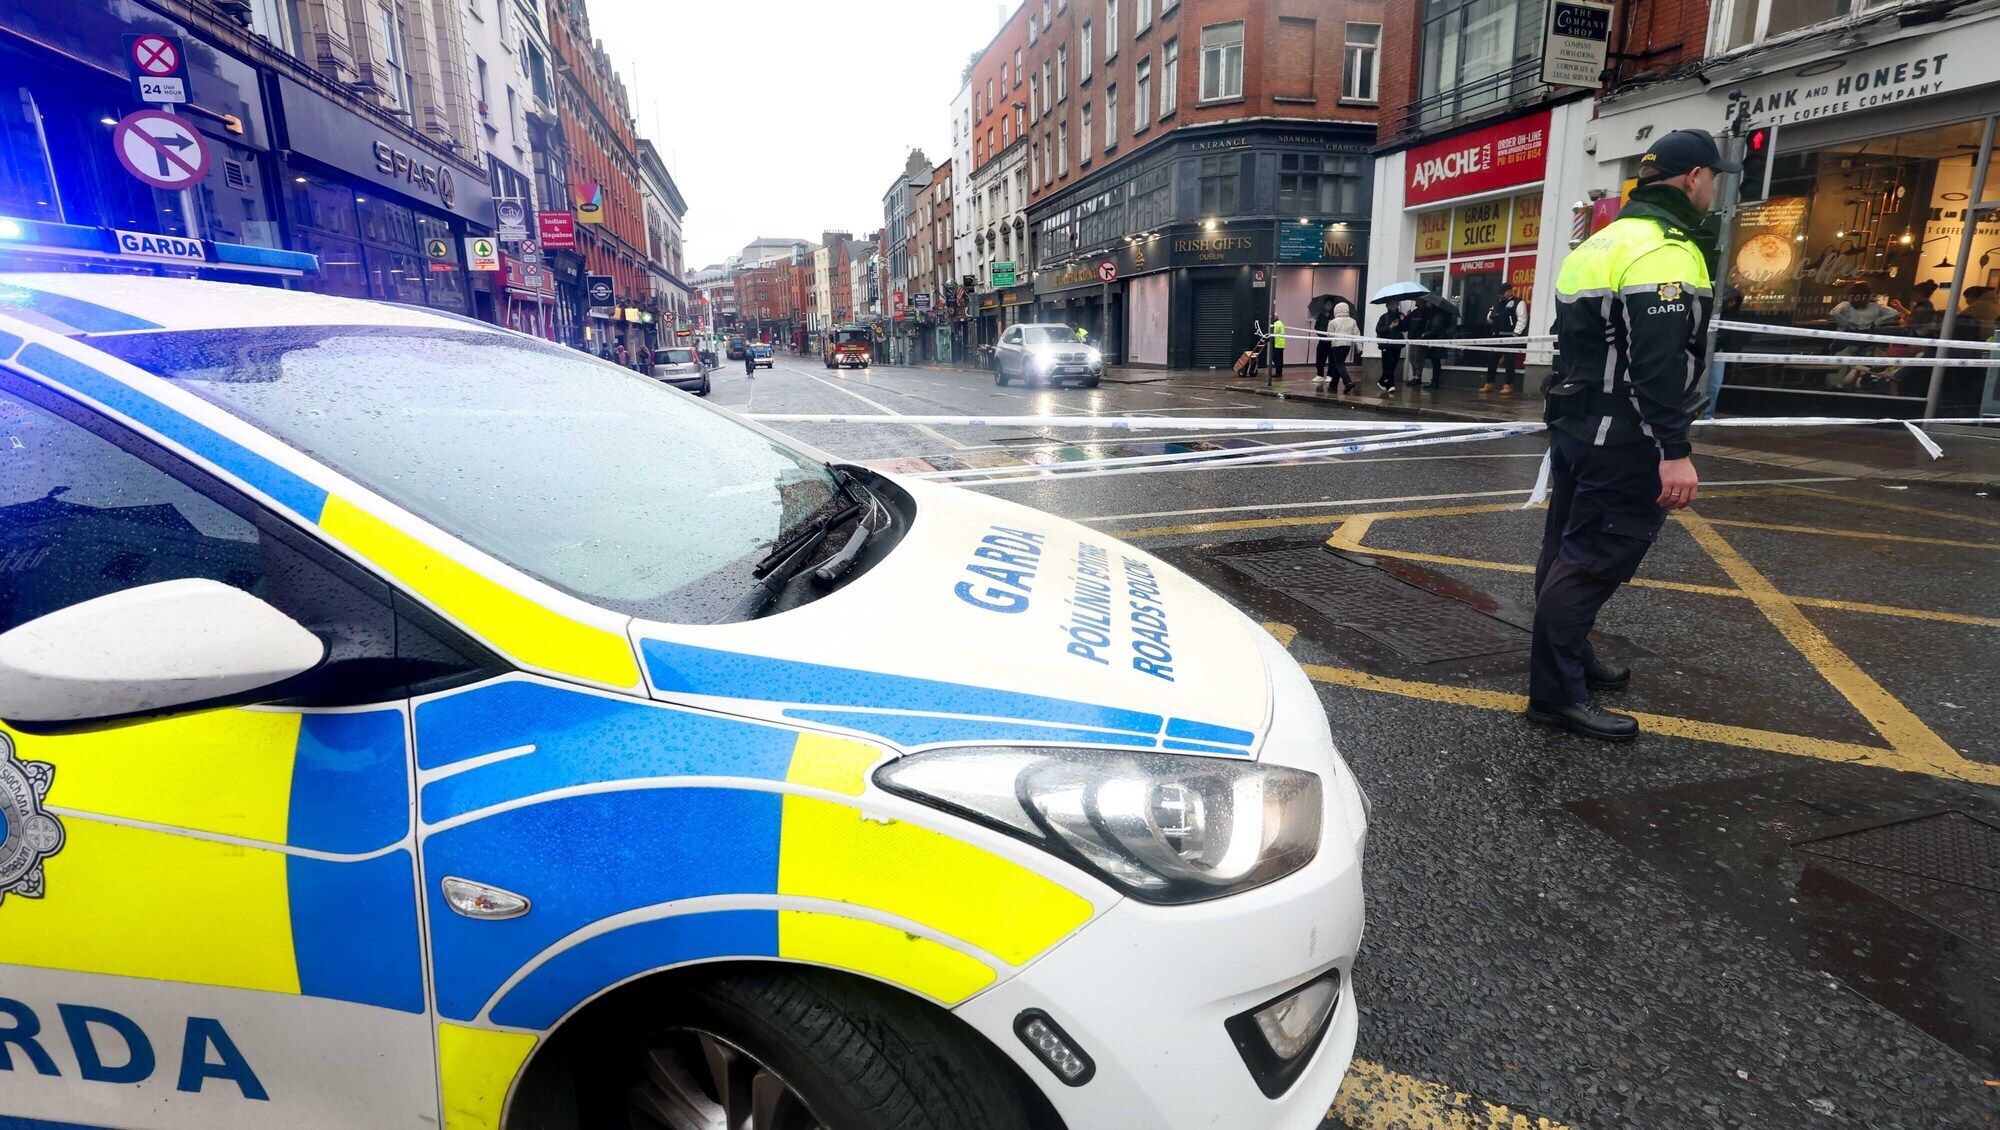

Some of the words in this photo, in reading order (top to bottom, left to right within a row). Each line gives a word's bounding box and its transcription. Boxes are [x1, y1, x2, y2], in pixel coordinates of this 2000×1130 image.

[1558, 10, 1604, 29] COMPANY
[1574, 8, 1592, 17] THE
[1568, 27, 1593, 37] SHOP
[1565, 41, 1591, 50] COMPANY
[1553, 71, 1570, 79] LEGAL
[142, 84, 161, 95] 24
[1725, 88, 1798, 120] FRANK
[1805, 86, 1828, 99] AND
[1836, 54, 1949, 97] HONEST
[1794, 101, 1849, 121] COFFEE
[1859, 80, 1944, 107] COMPANY
[1192, 138, 1248, 150] ENTRANCE
[1278, 135, 1325, 144] SHAMROCK
[1498, 137, 1516, 150] ORDER
[373, 141, 439, 196] SPAR
[1412, 147, 1481, 191] APACHE
[1482, 143, 1491, 170] PIZZA
[500, 205, 521, 218] City
[1465, 203, 1490, 224] GRAB
[1492, 203, 1499, 220] A
[1422, 213, 1447, 234] SLICE
[1464, 224, 1496, 245] SLICE!
[122, 235, 203, 258] GARDA
[1175, 239, 1210, 252] IRISH
[1213, 236, 1252, 251] GIFTS
[1323, 240, 1354, 257] NINE
[1200, 253, 1224, 261] DUBLIN
[1460, 261, 1485, 272] APACHE
[1647, 303, 1685, 315] GARD
[954, 525, 1046, 614] GARDA
[1129, 600, 1175, 683] ROADS
